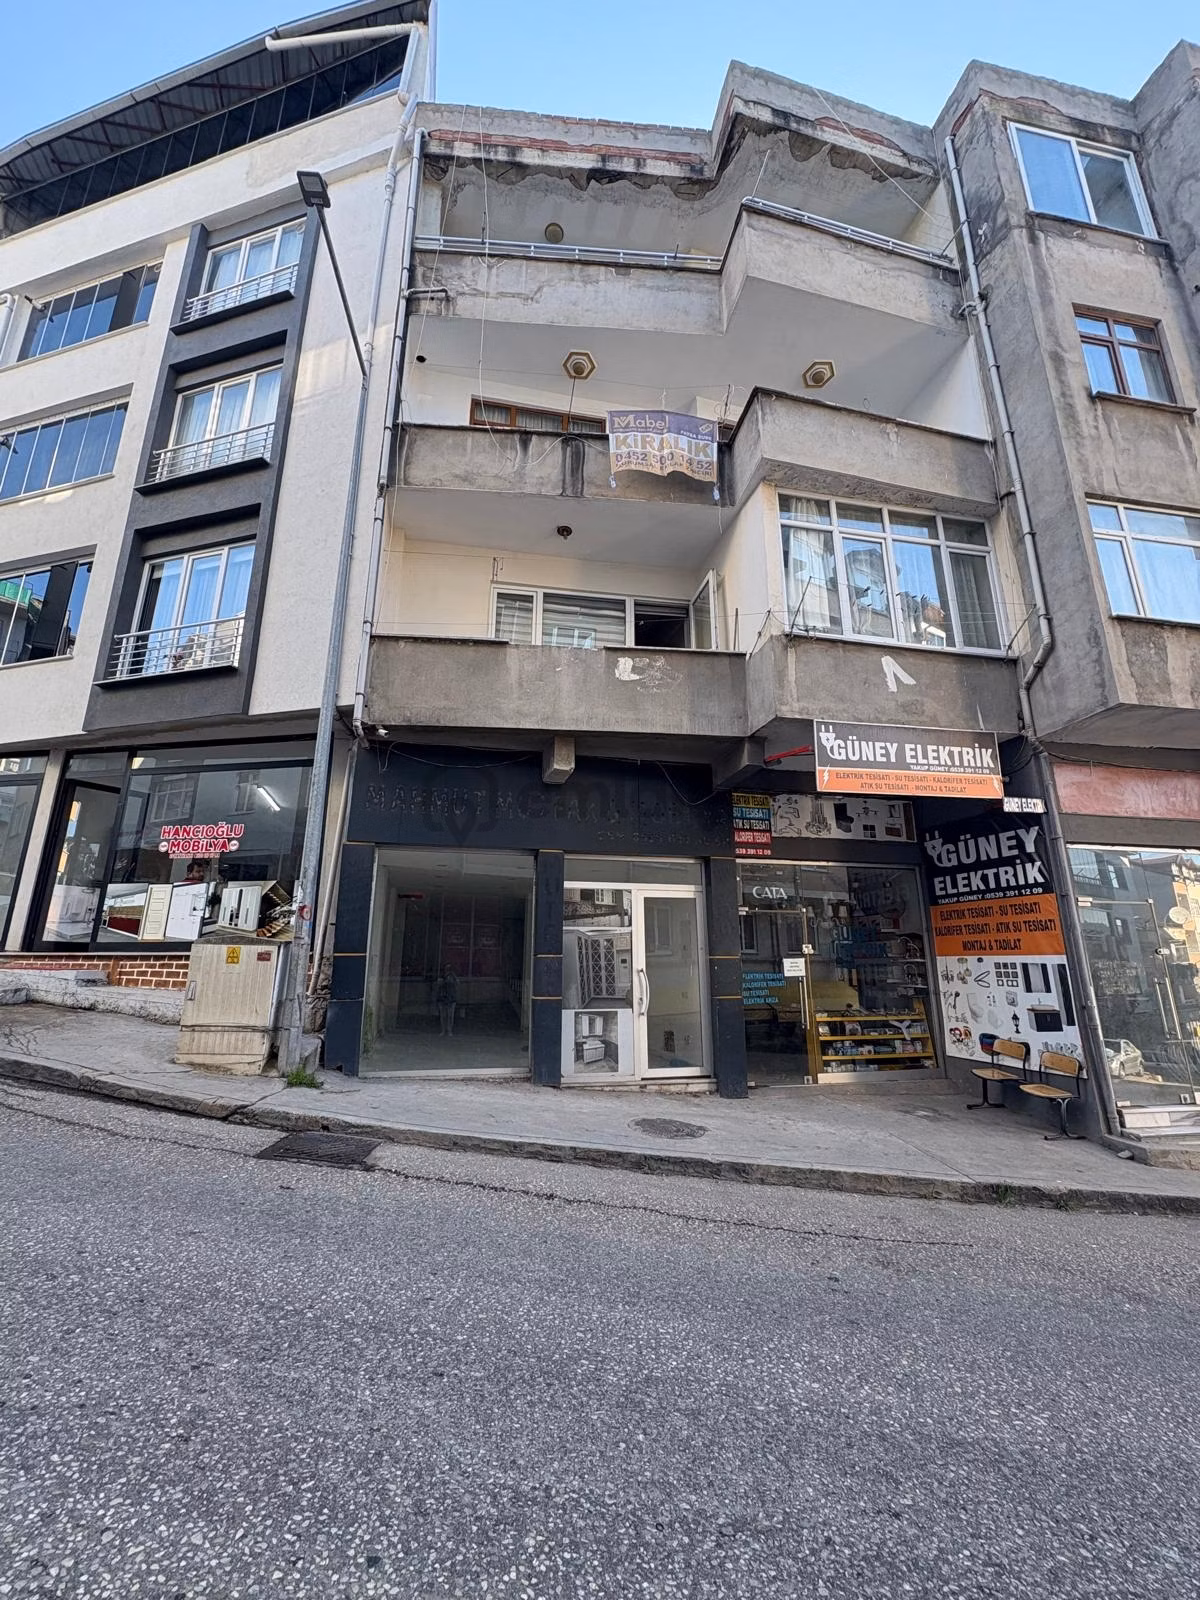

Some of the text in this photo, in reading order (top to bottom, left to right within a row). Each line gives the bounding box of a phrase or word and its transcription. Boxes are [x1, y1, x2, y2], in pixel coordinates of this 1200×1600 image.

[612, 414, 669, 433] Mabel
[616, 451, 648, 463] 0452
[652, 453, 675, 466] 500
[695, 460, 713, 471] 52
[834, 735, 995, 768] GÜNEY ELEKTRİK
[875, 782, 883, 790] SU
[914, 784, 938, 792] MONTAJ
[732, 807, 742, 817] SU
[160, 821, 245, 840] HANCIOĞLU
[940, 826, 1039, 867] GÜNEY
[934, 859, 1045, 896] ELEKTRİK
[752, 886, 788, 899] CATA
[937, 896, 958, 905] YAKUP
[959, 894, 983, 902] GÜNEY
[999, 905, 1009, 917] SU
[1010, 900, 1041, 915] TESİSATI
[996, 922, 1012, 934] ATIK
[1012, 921, 1022, 933] SU
[1023, 917, 1056, 932] TESİSATI
[962, 940, 987, 952] MONTAJ
[995, 936, 1021, 951] TADİLAT
